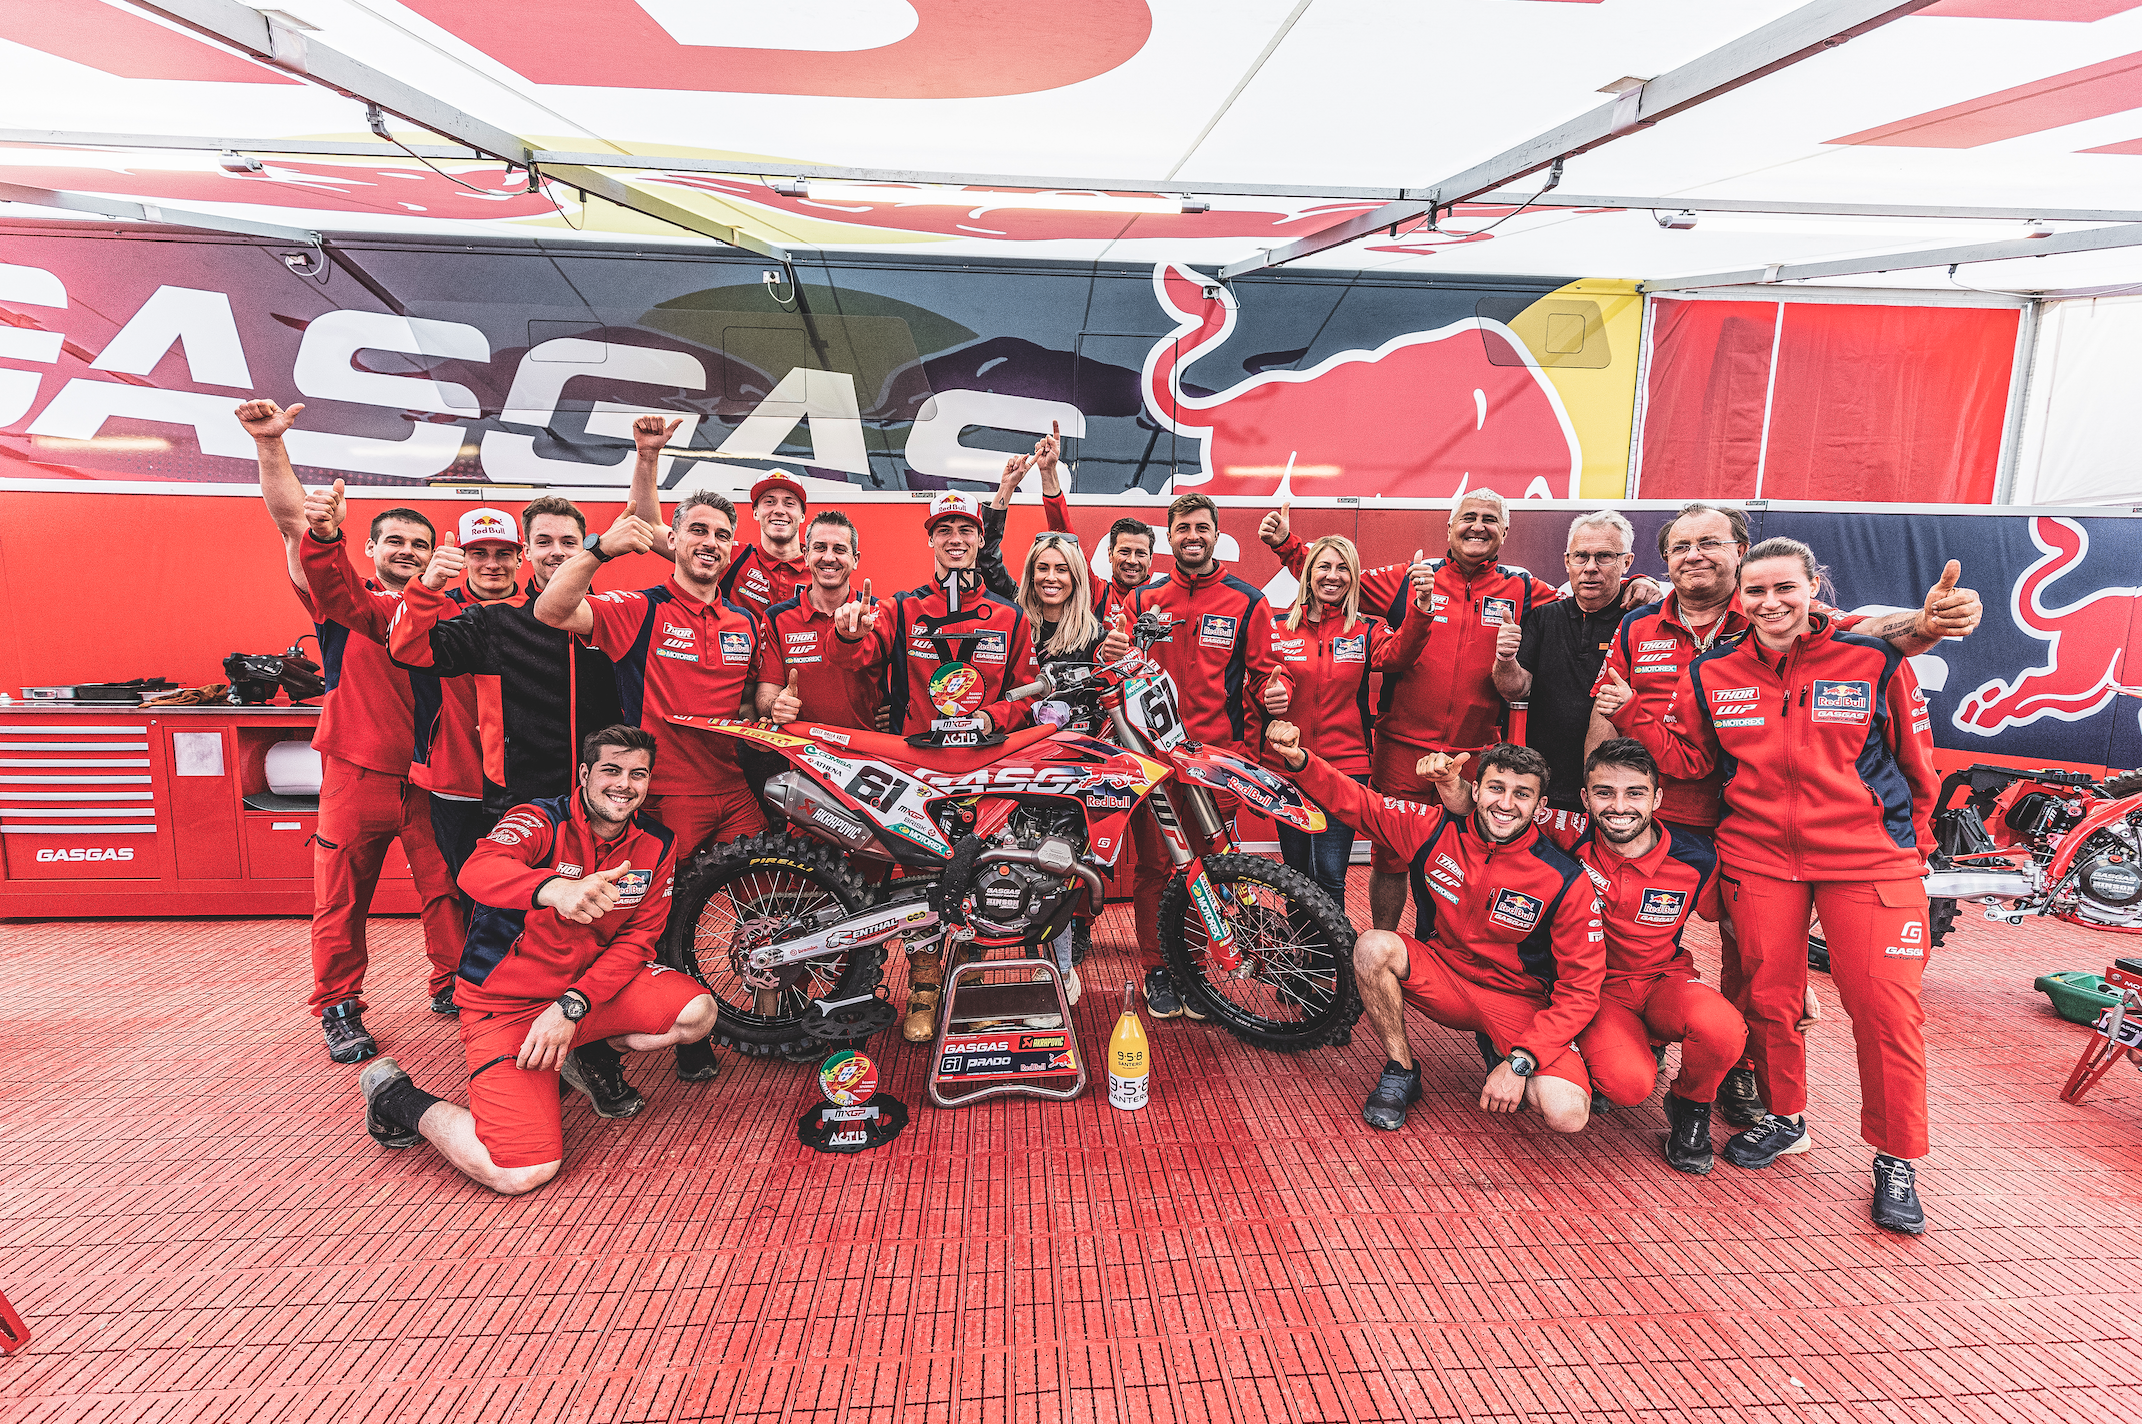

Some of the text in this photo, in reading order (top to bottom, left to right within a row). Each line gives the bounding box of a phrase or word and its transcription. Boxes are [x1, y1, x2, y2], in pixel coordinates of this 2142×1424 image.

[939, 504, 951, 513] Red
[472, 527, 487, 535] Red
[666, 624, 692, 638] THOR
[1204, 627, 1232, 637] Red Bull
[663, 638, 694, 649] WP
[788, 634, 814, 642] THOR
[1202, 638, 1230, 646] GASGAS
[724, 644, 750, 652] Red Bull
[788, 645, 816, 654] WP
[976, 642, 1004, 652] Red Bull
[1642, 641, 1674, 651] THOR
[666, 651, 697, 661] MOTOREX
[1637, 653, 1674, 662] WP
[1716, 690, 1756, 700] THOR
[1818, 697, 1866, 708] Red Bull
[1140, 677, 1181, 742] 61
[1715, 704, 1758, 716] WP
[1818, 710, 1866, 720] GASGAS
[1722, 718, 1762, 726] MOTOREX
[818, 751, 853, 770] COMISA
[814, 760, 842, 777] ATHENA
[845, 766, 910, 814] 61
[1227, 776, 1273, 807] Red Bull
[1087, 795, 1130, 808] Red Bull
[898, 806, 924, 820] MXGP
[904, 817, 926, 832] BRISK
[909, 830, 945, 852] MOTOREX
[36, 848, 134, 862] GASGAS
[749, 858, 814, 872] PIRELLI
[1439, 855, 1464, 878] THOR
[1430, 870, 1462, 888] WP
[631, 884, 648, 894] Bull
[1430, 880, 1459, 904] MOTOREX
[1498, 902, 1535, 922] Red Bull
[1644, 904, 1680, 914] Red Bull
[1197, 896, 1222, 939] MOTOREX
[1494, 913, 1531, 928] GASGAS
[944, 1042, 1009, 1054] GASGAS
[941, 1056, 1012, 1072] 61 PRADO
[1020, 1064, 1032, 1072] Red
[835, 1110, 866, 1118] MXGP
